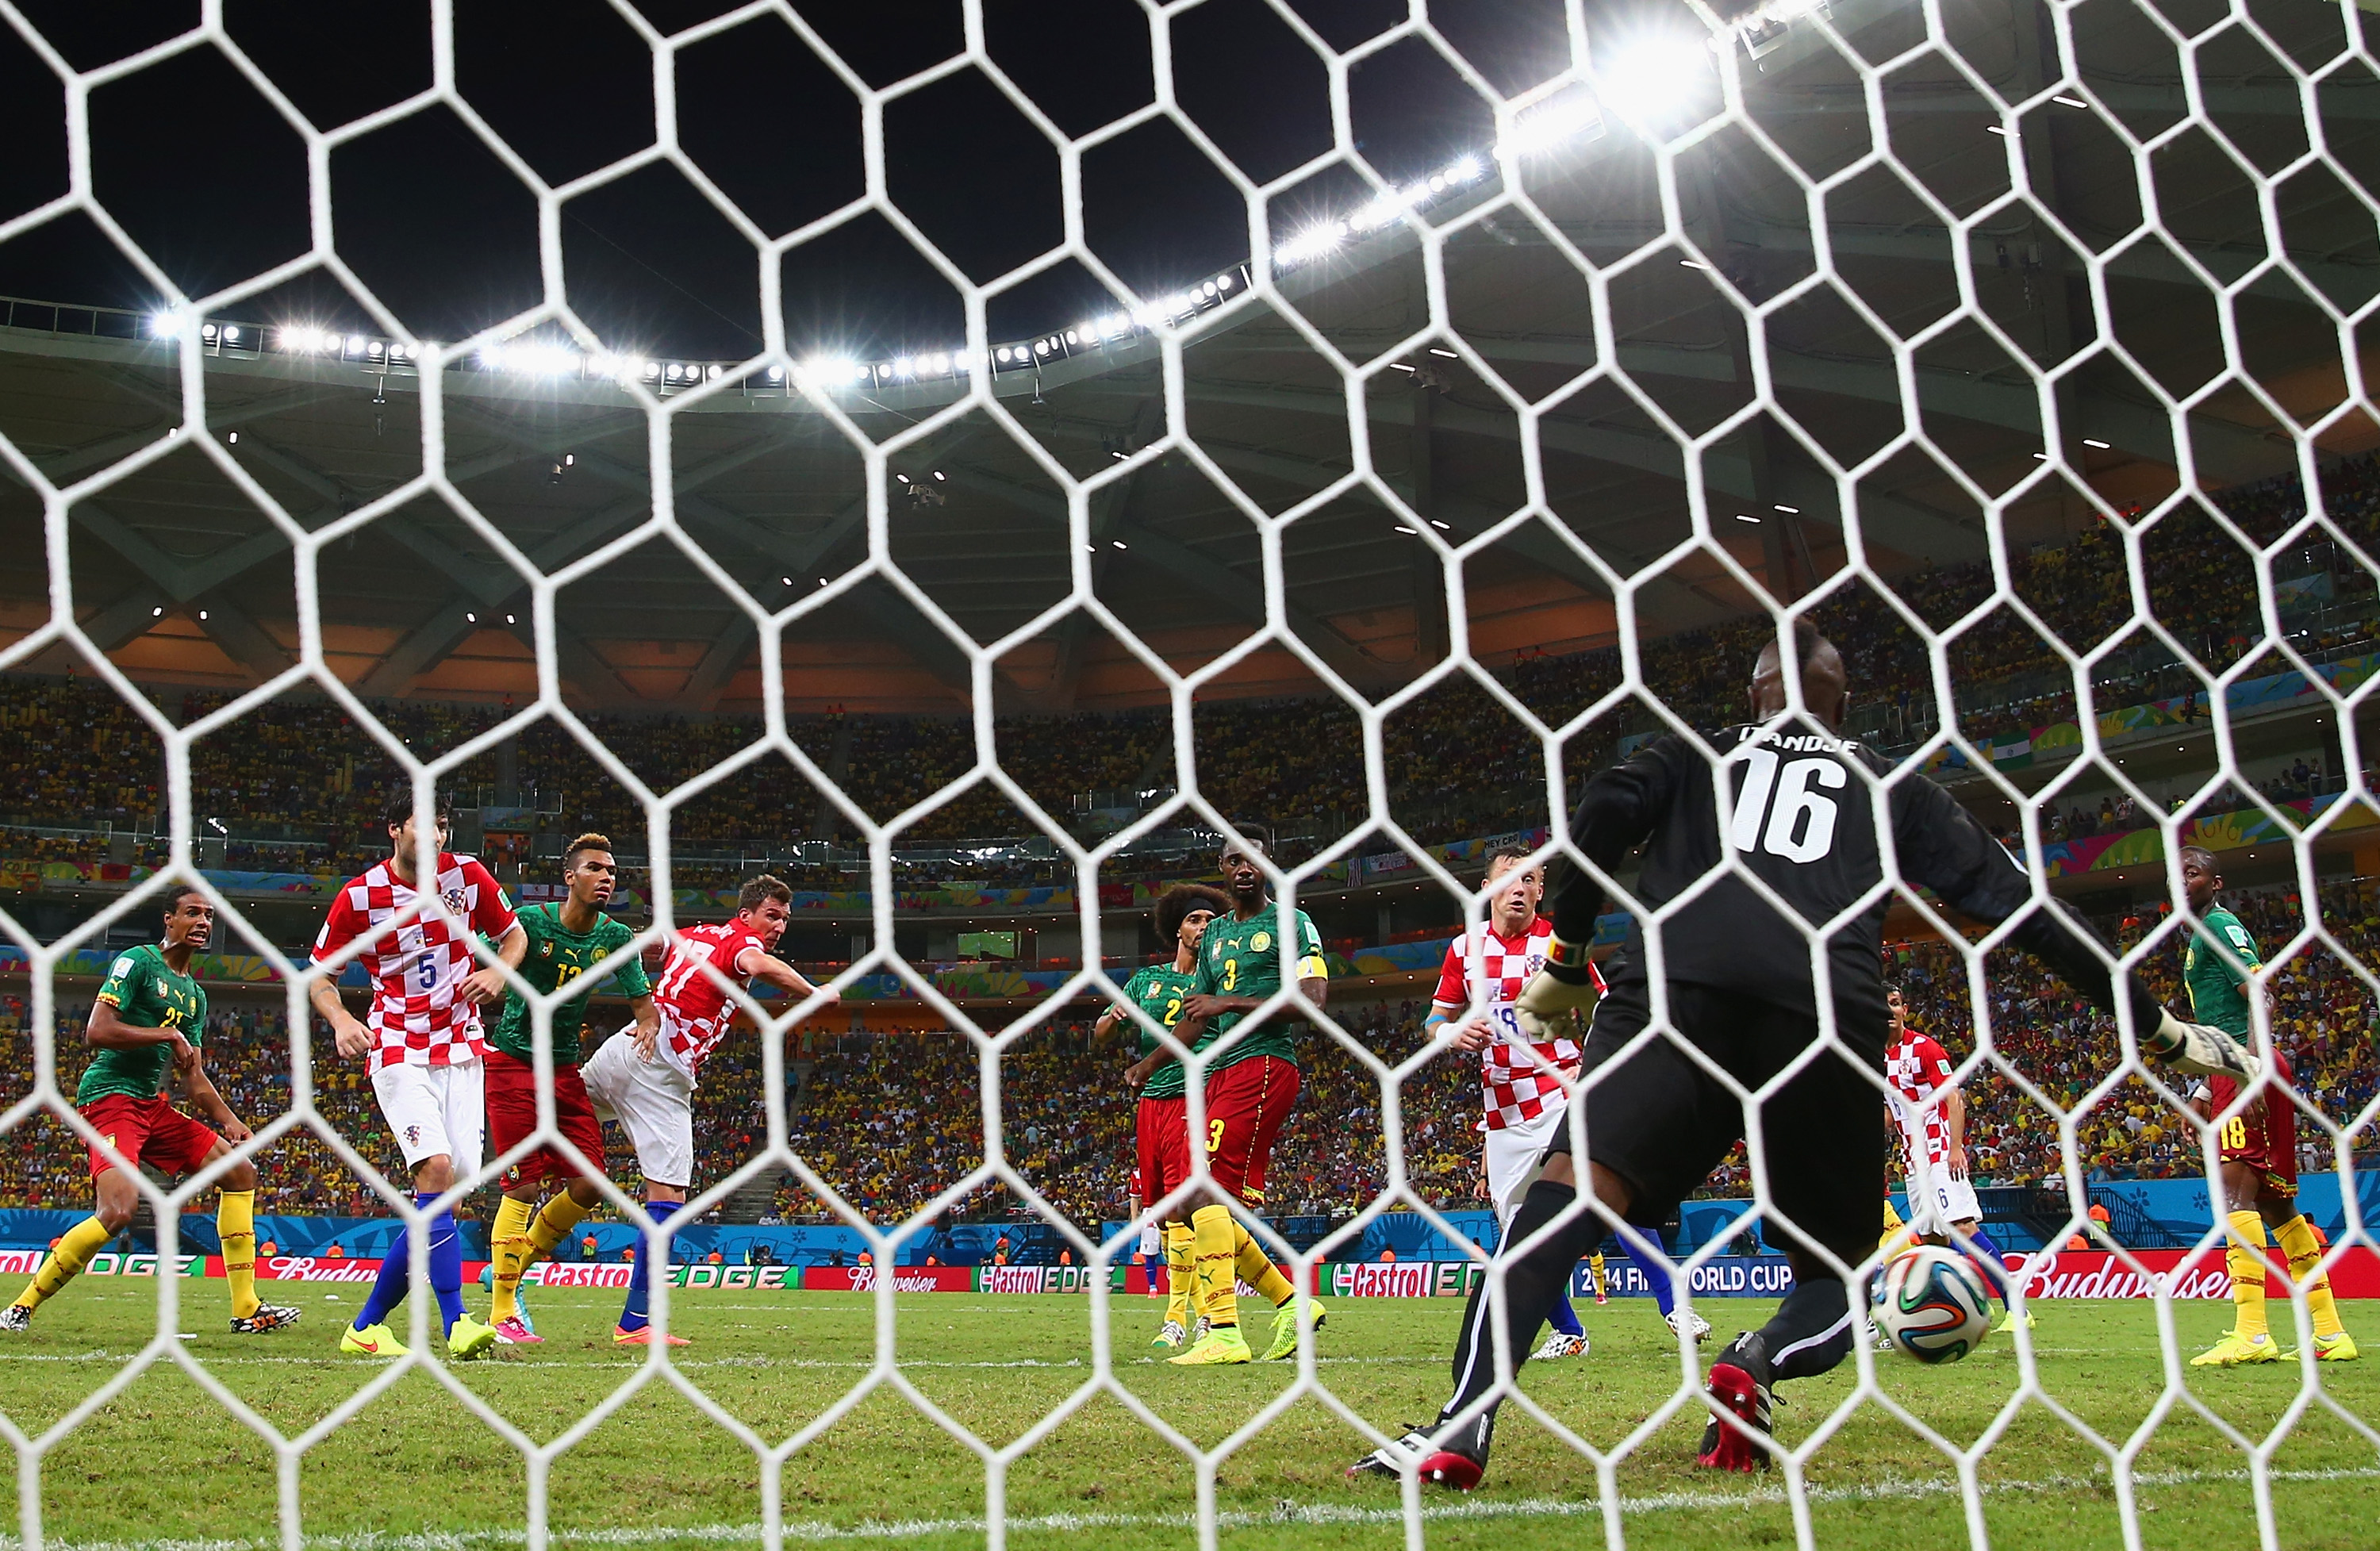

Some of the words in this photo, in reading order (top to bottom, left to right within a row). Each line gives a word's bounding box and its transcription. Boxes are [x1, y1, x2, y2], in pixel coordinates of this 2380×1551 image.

[1731, 747, 1848, 864] 16
[1484, 839, 1500, 848] HEY
[417, 954, 437, 989] 5
[656, 938, 716, 1000] 17
[1223, 959, 1237, 992] 3
[159, 1007, 183, 1029] 21
[1164, 999, 1181, 1026] 2
[1204, 1119, 1225, 1152] 3
[2221, 1115, 2246, 1150] 18
[1937, 1188, 1948, 1209] 6
[84, 1253, 197, 1277] DGE
[543, 1262, 629, 1288] Castro
[665, 1265, 789, 1288] EDGE
[1581, 1267, 1622, 1291] 214
[1686, 1266, 1745, 1292] ORLD
[1750, 1265, 1793, 1292] CUP
[847, 1266, 936, 1292] Buweiser
[992, 1266, 1040, 1293] Castrol
[1353, 1264, 1427, 1297] Castrol
